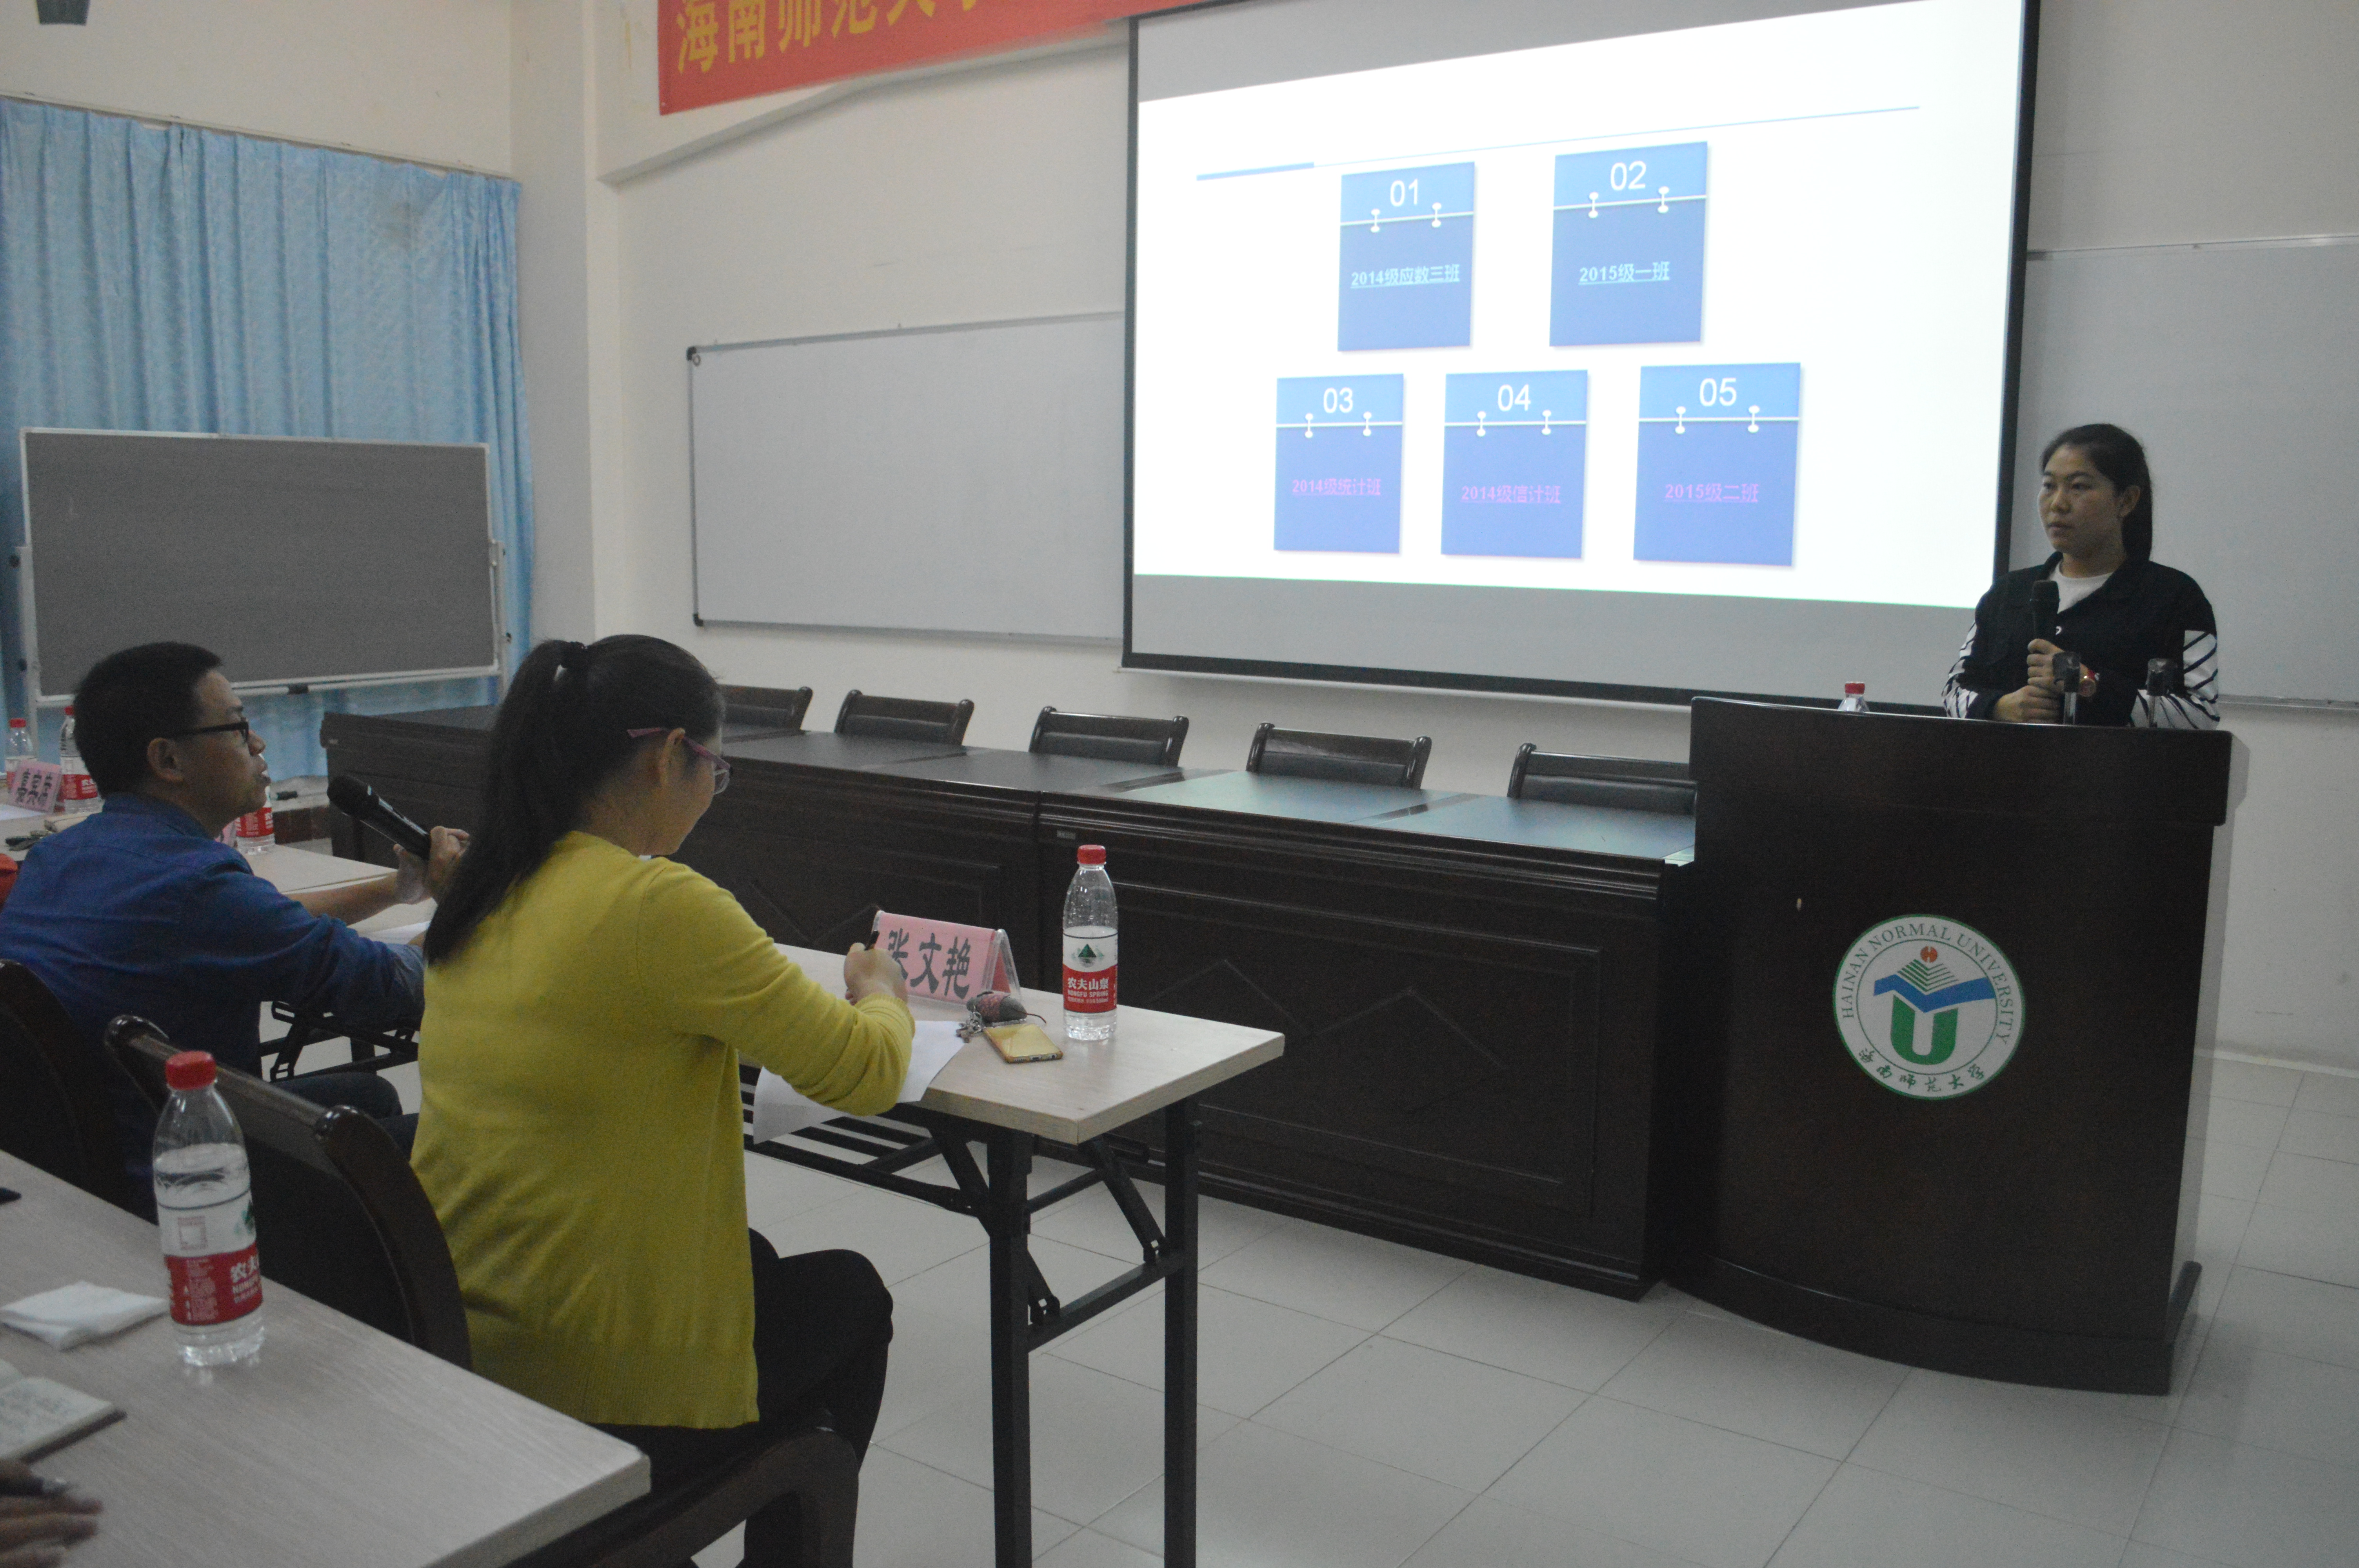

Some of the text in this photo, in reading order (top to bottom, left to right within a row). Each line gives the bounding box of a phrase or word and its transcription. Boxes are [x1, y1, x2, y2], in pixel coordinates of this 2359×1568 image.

[676, 0, 976, 73] 海南师
[1610, 161, 1646, 191] 02
[1390, 178, 1418, 207] 01
[1351, 264, 1460, 287] 2014级应数三班
[1579, 261, 1670, 283] 2015级一班
[1323, 387, 1353, 413] 03
[1498, 384, 1531, 412] 04
[1699, 377, 1737, 407] 05
[1292, 478, 1381, 495] 2014级统计班
[1461, 485, 1561, 504] 2014级信计班
[1665, 483, 1759, 502] 2015级二班
[888, 928, 971, 999] 张文艳
[1068, 977, 1109, 990] 农夫山泉
[1068, 989, 1087, 998] NONGFU
[1841, 923, 2014, 1045] HAINAN NORMAL UNIVERSITY
